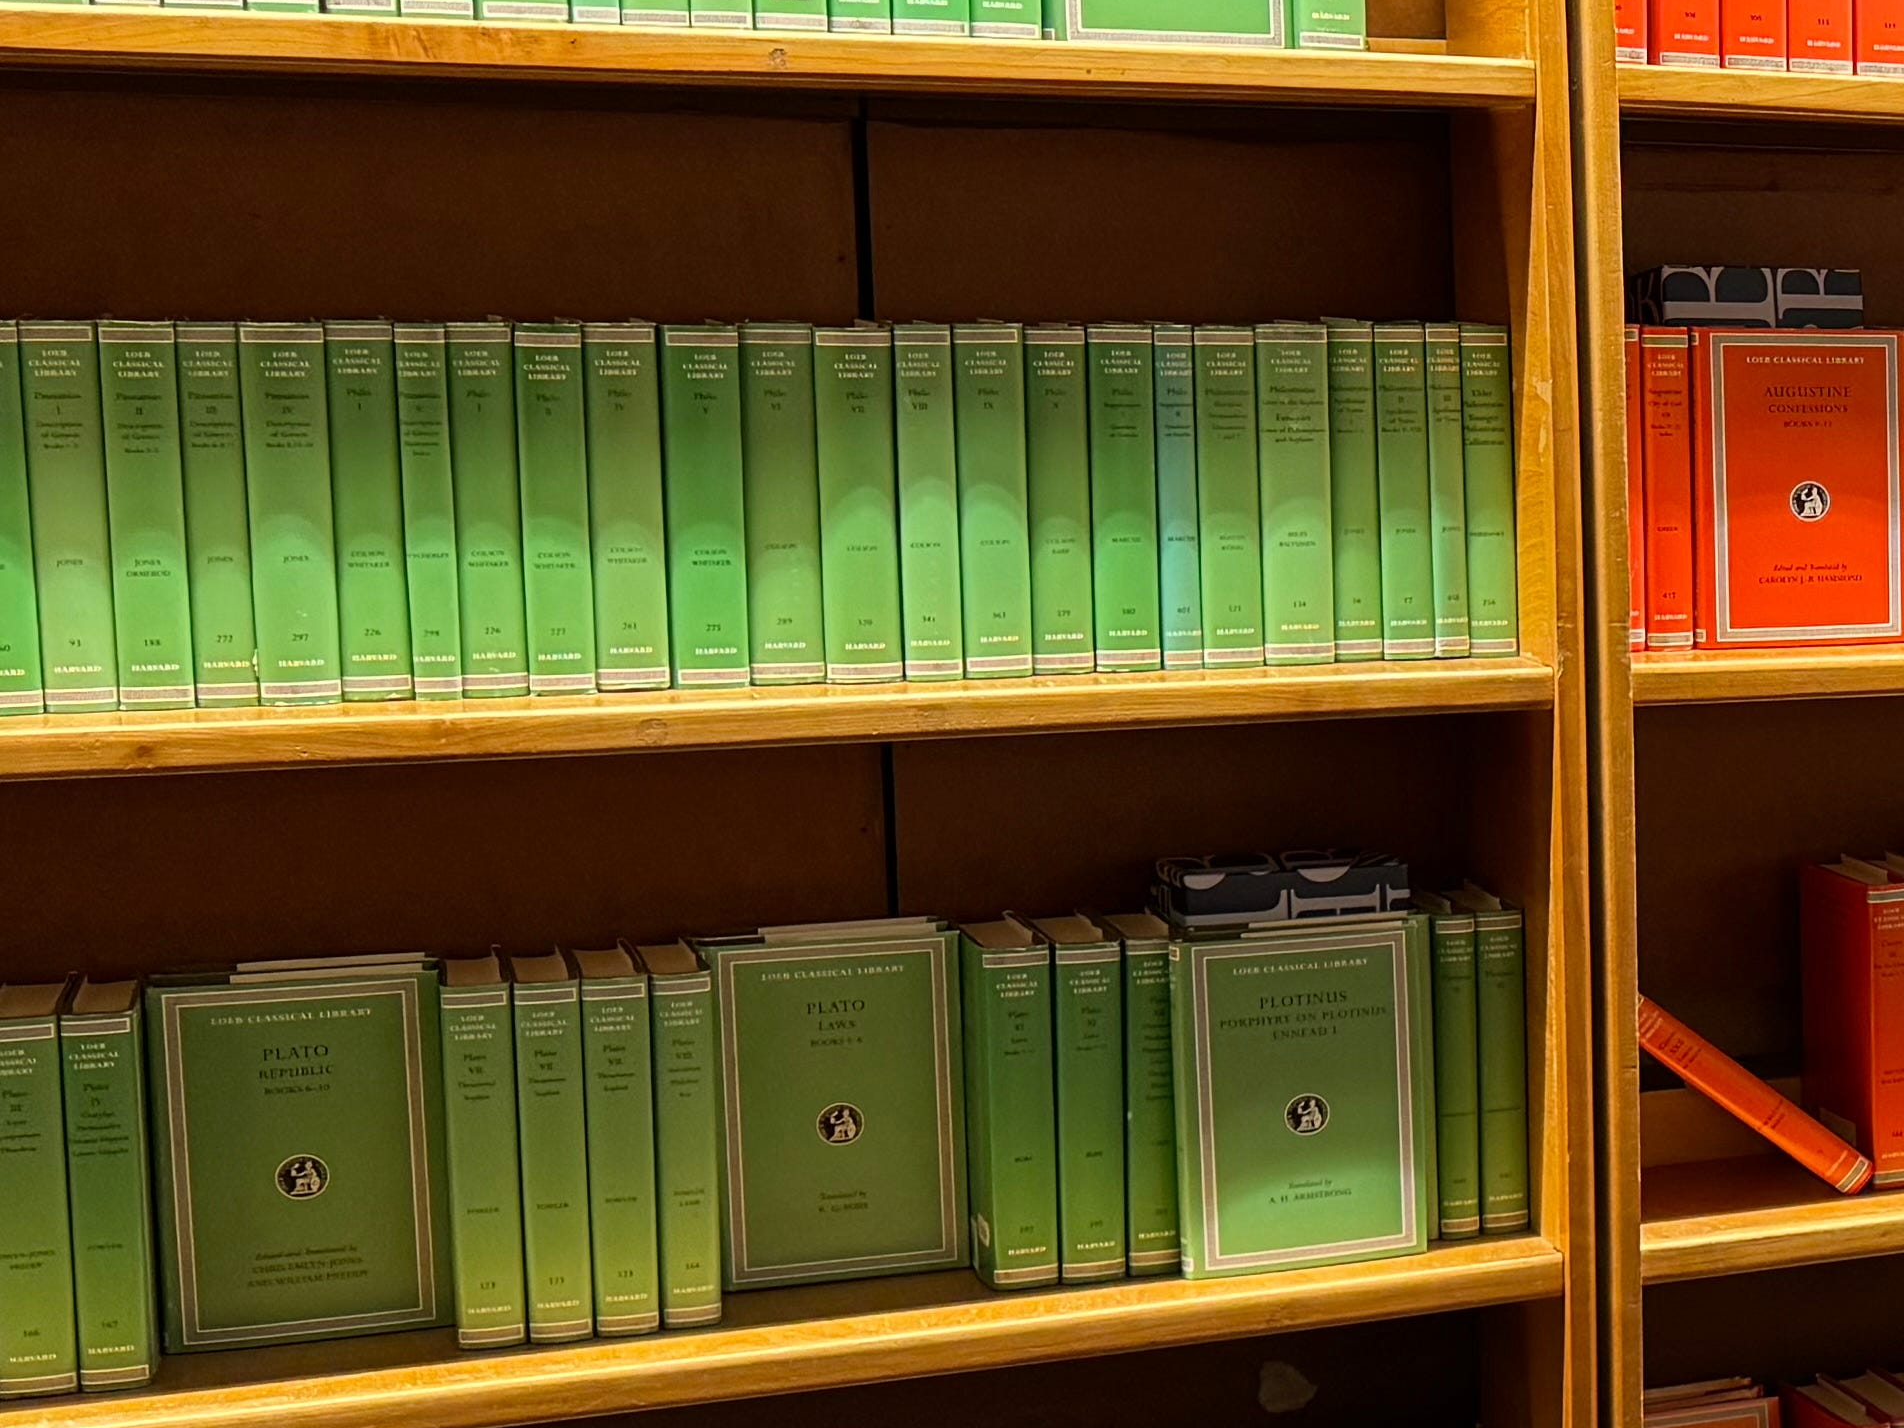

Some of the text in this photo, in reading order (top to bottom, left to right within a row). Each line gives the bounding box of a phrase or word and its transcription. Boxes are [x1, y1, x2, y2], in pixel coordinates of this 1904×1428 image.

[1746, 356, 1864, 365] LOEB CLASSICAL LIBRARY
[1765, 386, 1851, 398] AUGUSTINE
[806, 999, 865, 1015] PLATO
[1259, 990, 1347, 1009] PLOTINUS
[1322, 1006, 1387, 1020] PLOTINUS
[818, 1020, 856, 1032] LAWS
[262, 1044, 329, 1062] PLATO
[259, 1064, 334, 1081] REPUBLIC
